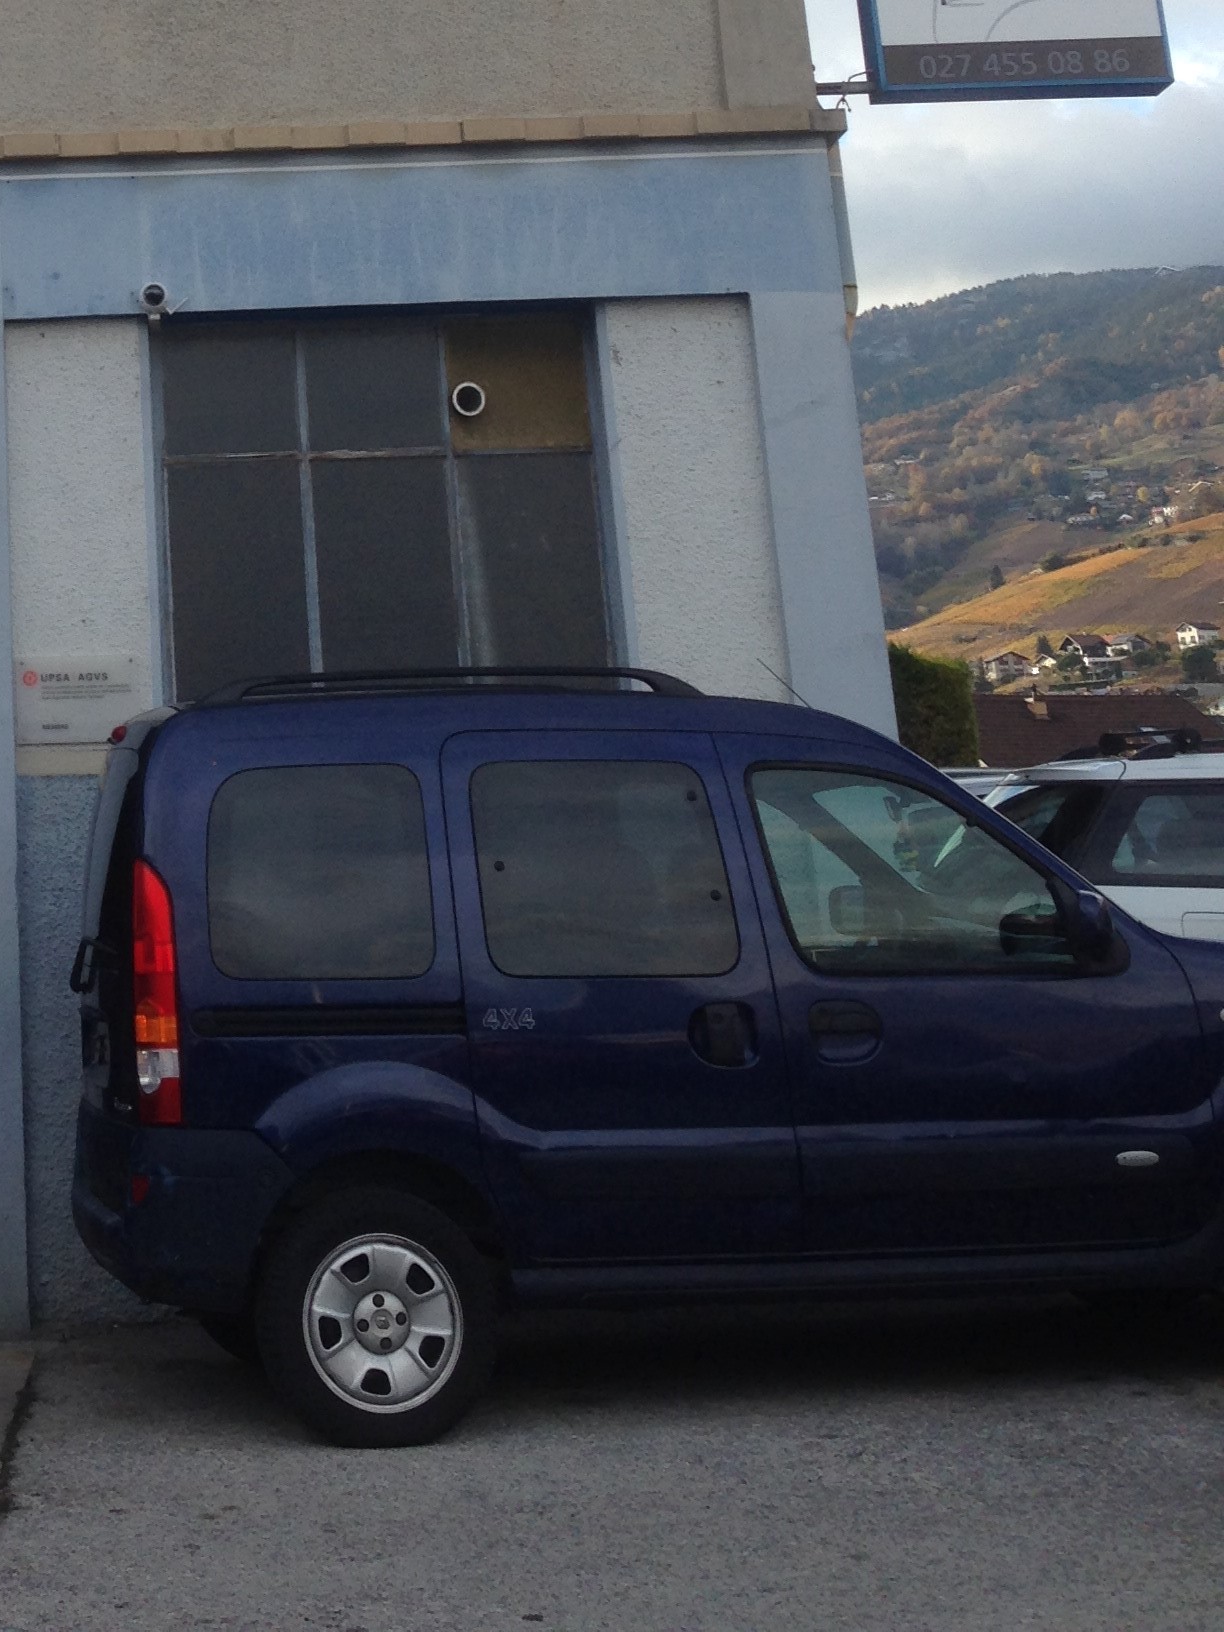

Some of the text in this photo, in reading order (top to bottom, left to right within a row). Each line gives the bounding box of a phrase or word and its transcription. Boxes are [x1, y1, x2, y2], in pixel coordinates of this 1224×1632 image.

[919, 48, 1130, 79] 027 455 08 86
